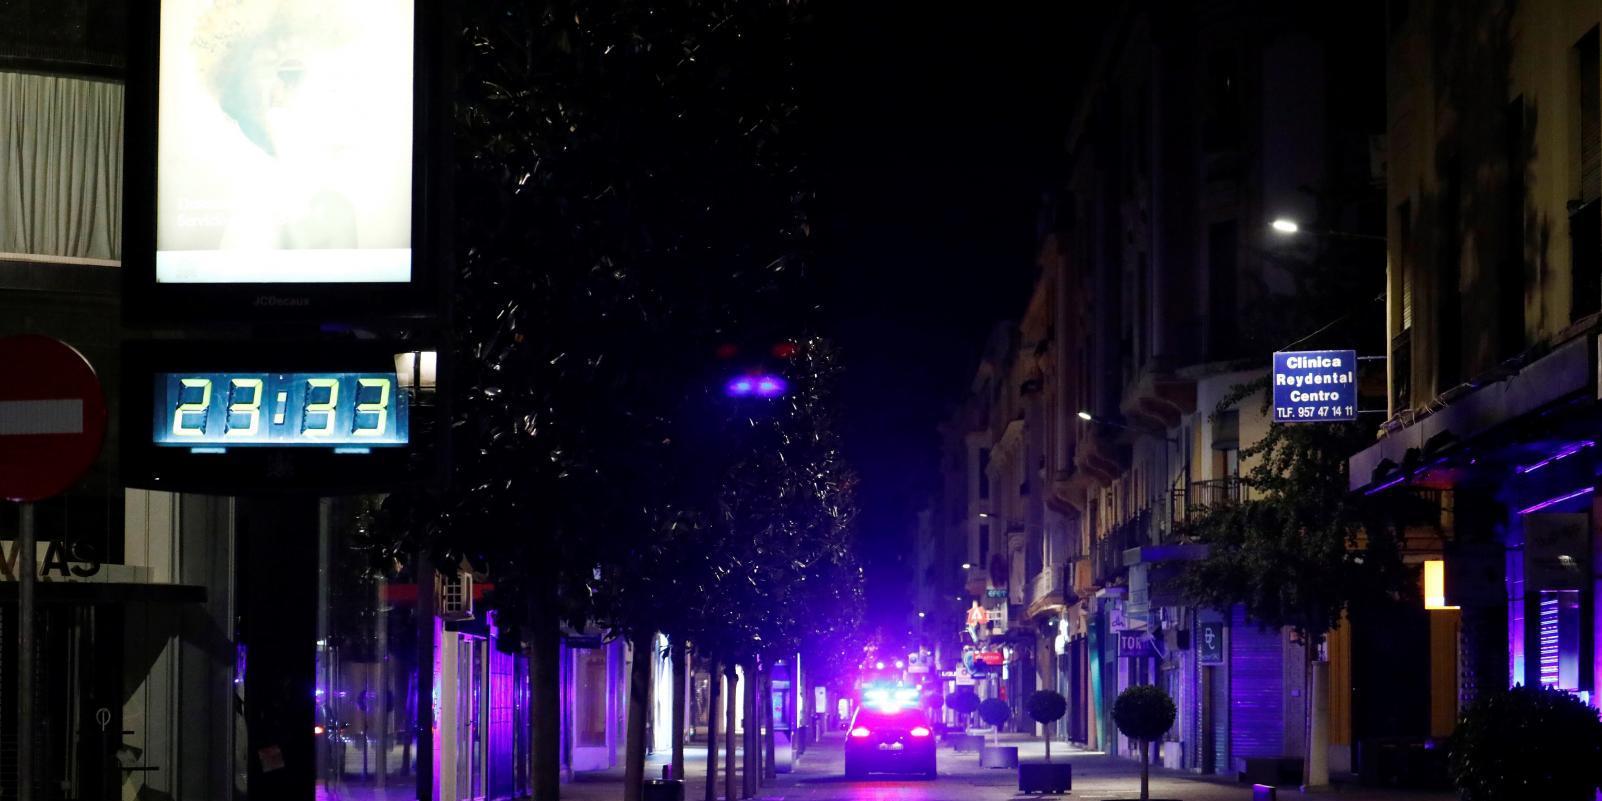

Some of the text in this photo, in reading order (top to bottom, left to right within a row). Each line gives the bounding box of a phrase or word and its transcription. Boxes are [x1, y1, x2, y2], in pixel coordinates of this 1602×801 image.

[1276, 371, 1353, 387] Reydental
[1290, 390, 1340, 402] Centro
[172, 378, 391, 436] 23:33
[1276, 405, 1353, 418] TLF. 957 47 14 11
